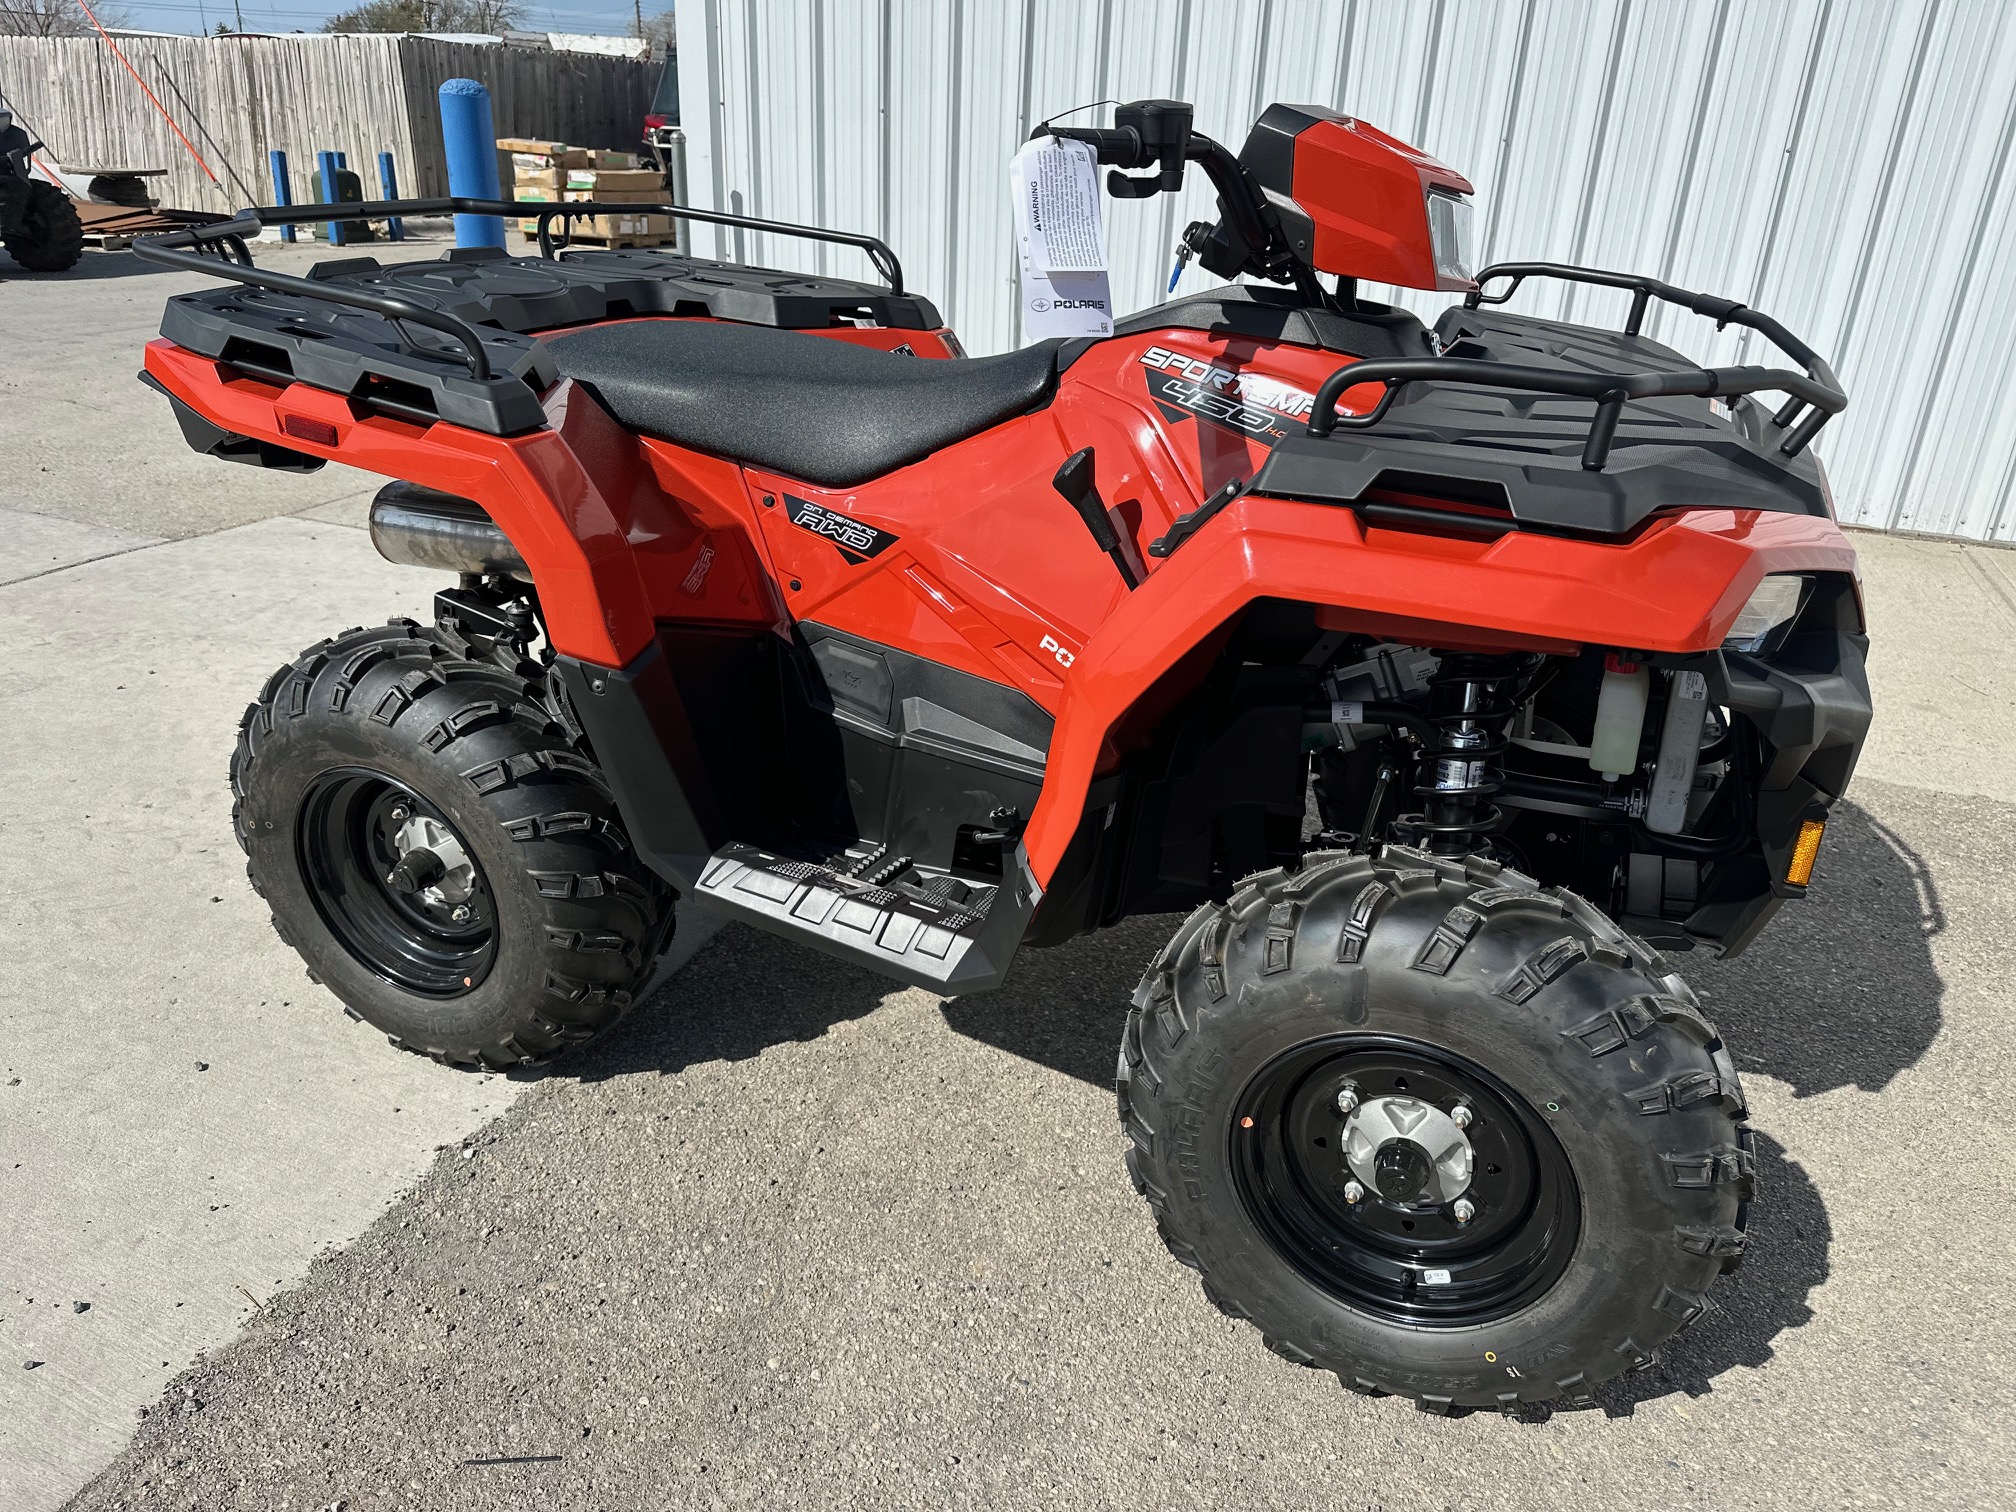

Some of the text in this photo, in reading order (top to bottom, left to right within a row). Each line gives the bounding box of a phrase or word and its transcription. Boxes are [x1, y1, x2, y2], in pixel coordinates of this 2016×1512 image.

[1031, 180, 1041, 223] WARNING
[1054, 300, 1105, 309] POLARIS
[793, 510, 872, 550] AWD
[803, 503, 878, 537] ON DEMAND
[1177, 1048, 1226, 1201] POLARIS
